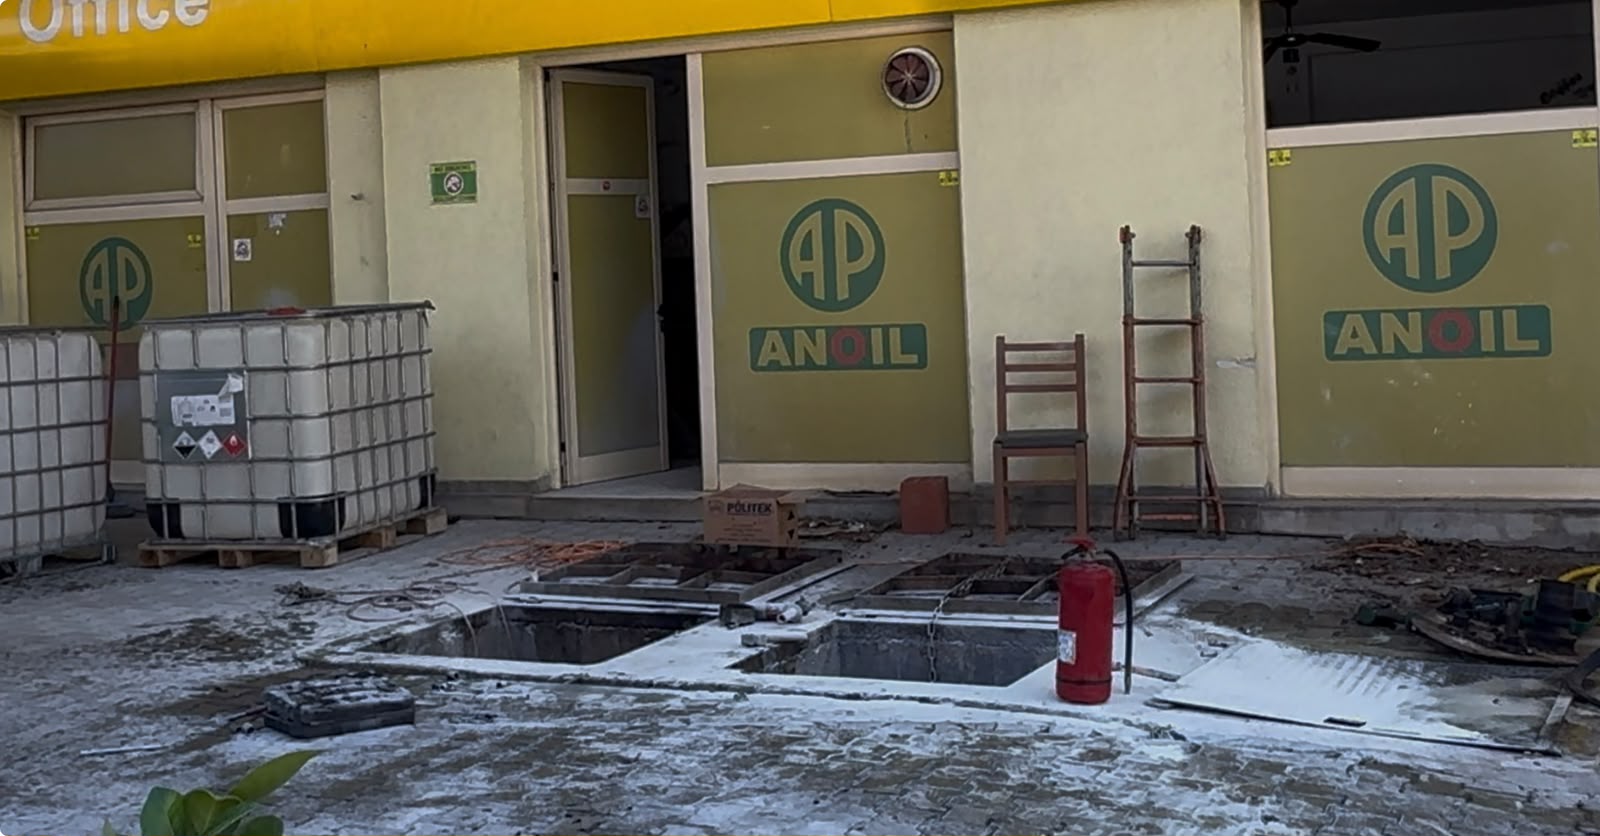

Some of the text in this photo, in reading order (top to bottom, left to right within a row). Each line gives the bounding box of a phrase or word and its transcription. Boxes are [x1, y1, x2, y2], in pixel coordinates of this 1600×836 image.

[788, 208, 876, 301] AP
[1373, 174, 1485, 281] AP
[85, 246, 146, 323] AP
[756, 326, 919, 367] ANOIL
[1333, 308, 1541, 355] ANOIL
